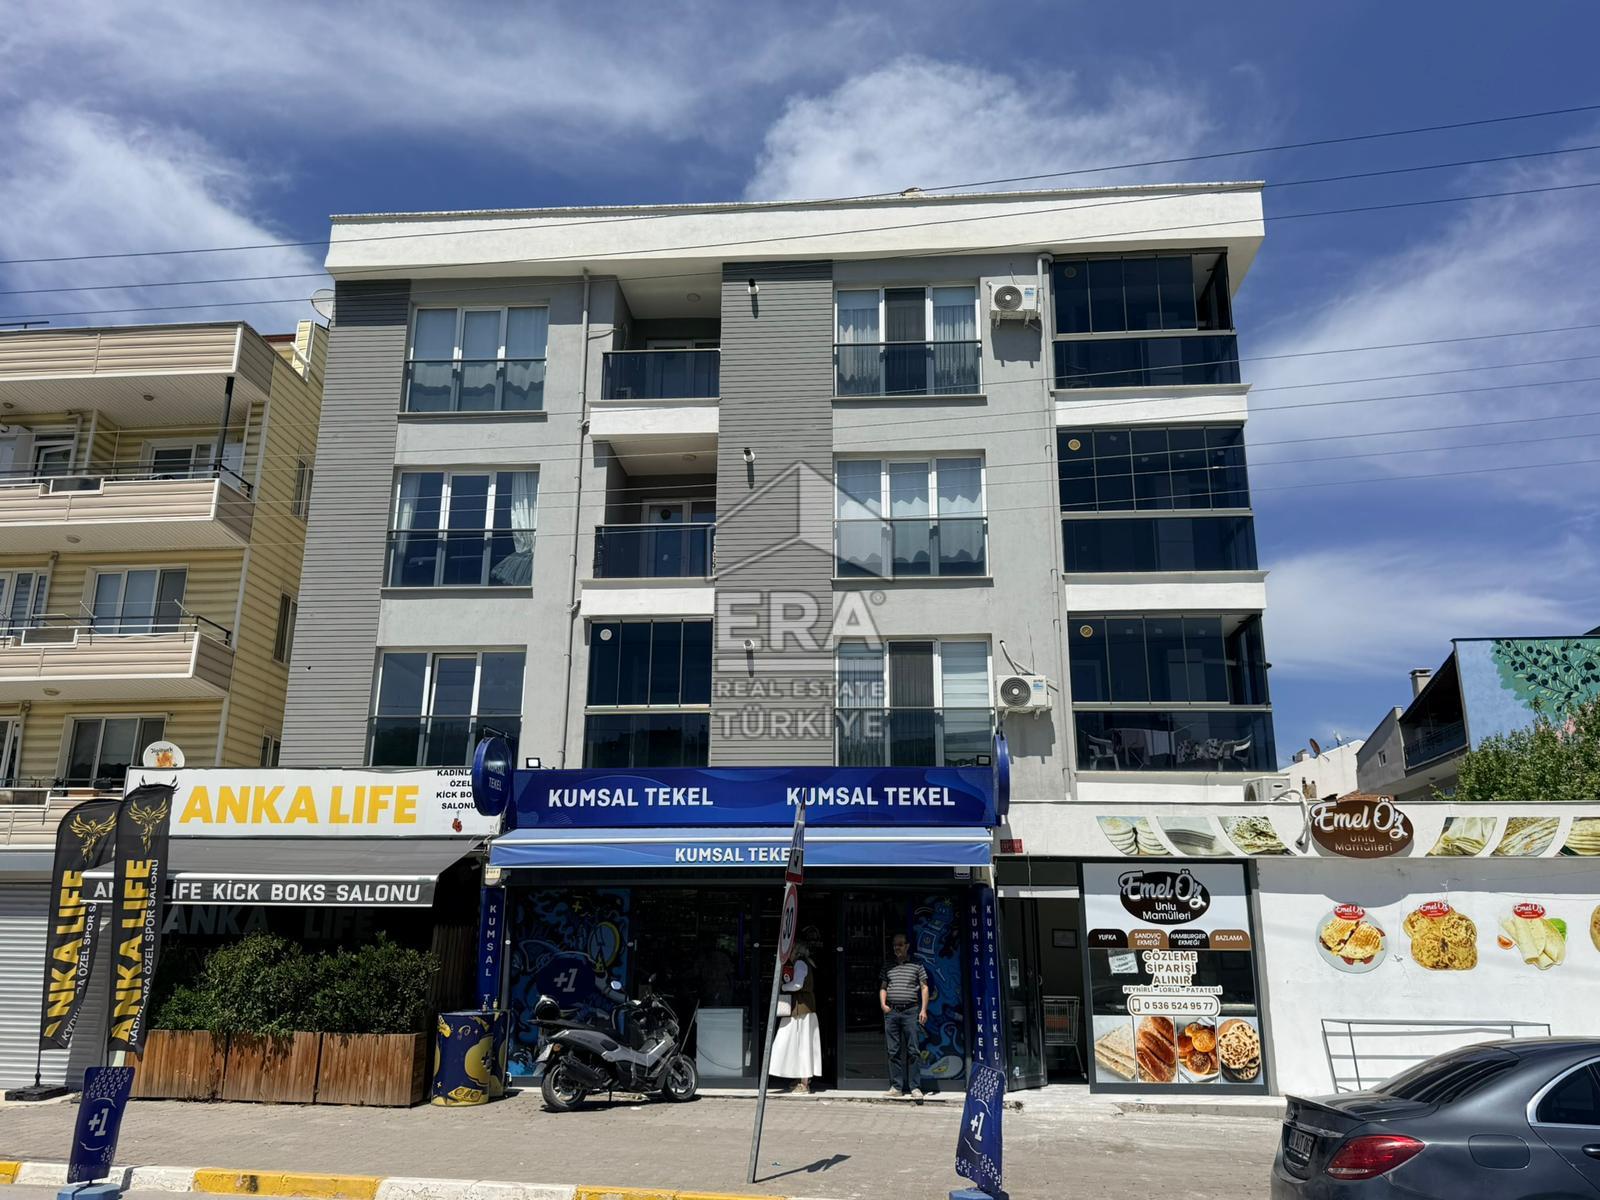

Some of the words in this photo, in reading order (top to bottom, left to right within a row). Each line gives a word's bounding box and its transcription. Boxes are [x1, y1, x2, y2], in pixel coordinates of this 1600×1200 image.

[436, 790, 458, 799] KİCK
[460, 791, 473, 799] BO
[450, 779, 472, 788] ÖZEL
[488, 777, 502, 791] TEKEL
[179, 785, 319, 824] ANKA
[328, 785, 419, 824] LIFE
[441, 802, 477, 810] SALONU
[548, 788, 639, 808] KUMSAL
[644, 787, 714, 806] TEKEL
[786, 787, 879, 806] KUMSAL
[884, 787, 956, 806] TEKEL
[1310, 801, 1372, 831] Emel
[1373, 797, 1409, 839] Öz
[675, 847, 745, 862] KUMSAL
[748, 847, 792, 862] TEKE
[1335, 842, 1393, 852] Mamülleri
[122, 859, 153, 928] LIFE
[148, 859, 159, 907] SALONU
[164, 880, 202, 899] İFE
[213, 880, 261, 901] KİCK
[271, 882, 326, 901] BOKS
[336, 883, 420, 902] SALONU
[1119, 871, 1174, 901] Emel
[1175, 869, 1207, 909] Öz
[1142, 911, 1191, 921] Mamülleri
[1155, 902, 1177, 911] Unlu
[83, 914, 95, 945] SPOR
[145, 909, 156, 942] SPOR
[783, 907, 794, 940] 30
[485, 905, 497, 977] KUMSAL
[143, 944, 154, 975] ÖZEL
[1143, 950, 1197, 962] GÖZLEME
[1146, 962, 1195, 975] SİPARİŞİ
[1153, 975, 1191, 985] ALINIR
[112, 933, 143, 1042] ANKA
[553, 968, 578, 993] +1
[971, 905, 981, 979] KUMSAL
[976, 997, 984, 1060] TEKEL
[986, 905, 995, 979] KUMSAL
[992, 997, 1000, 1060] TEKEL
[1124, 985, 1153, 993] PEYNİRLİ
[1186, 986, 1222, 994] PATATESLİ
[1152, 1002, 1169, 1010] 536
[1171, 1002, 1188, 1010] 524
[1190, 1002, 1201, 1010] 95
[1204, 1002, 1213, 1010] 77
[88, 1107, 109, 1137] +1
[970, 1111, 985, 1142] +1
